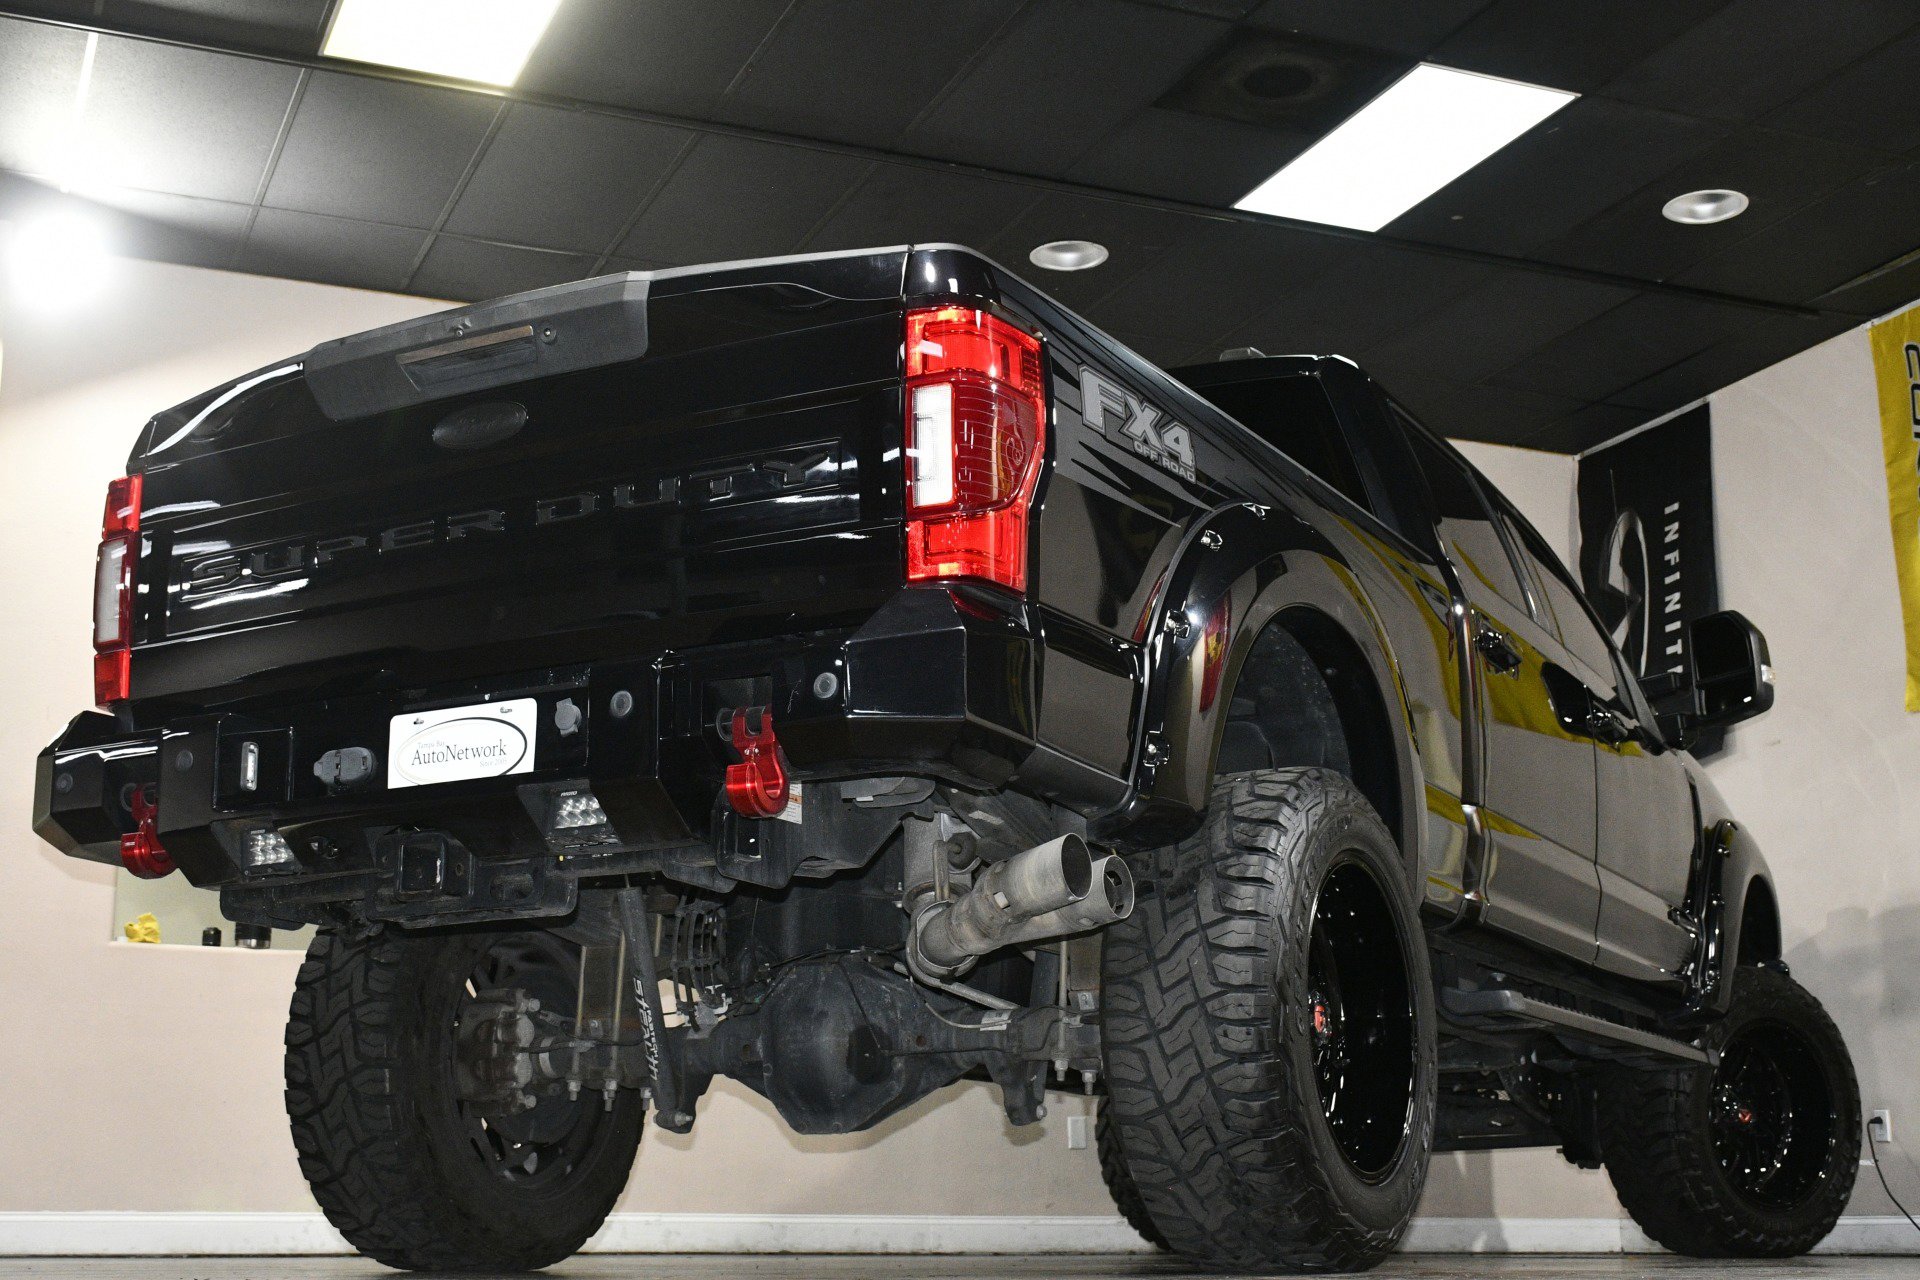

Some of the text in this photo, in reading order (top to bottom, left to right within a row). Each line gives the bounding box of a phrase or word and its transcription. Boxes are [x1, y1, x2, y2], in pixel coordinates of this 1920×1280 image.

[1079, 365, 1196, 472] FX4
[1133, 440, 1196, 482] OFF ROAD
[190, 450, 831, 592] SUPER DUTY
[411, 739, 507, 766] AutoNetwork
